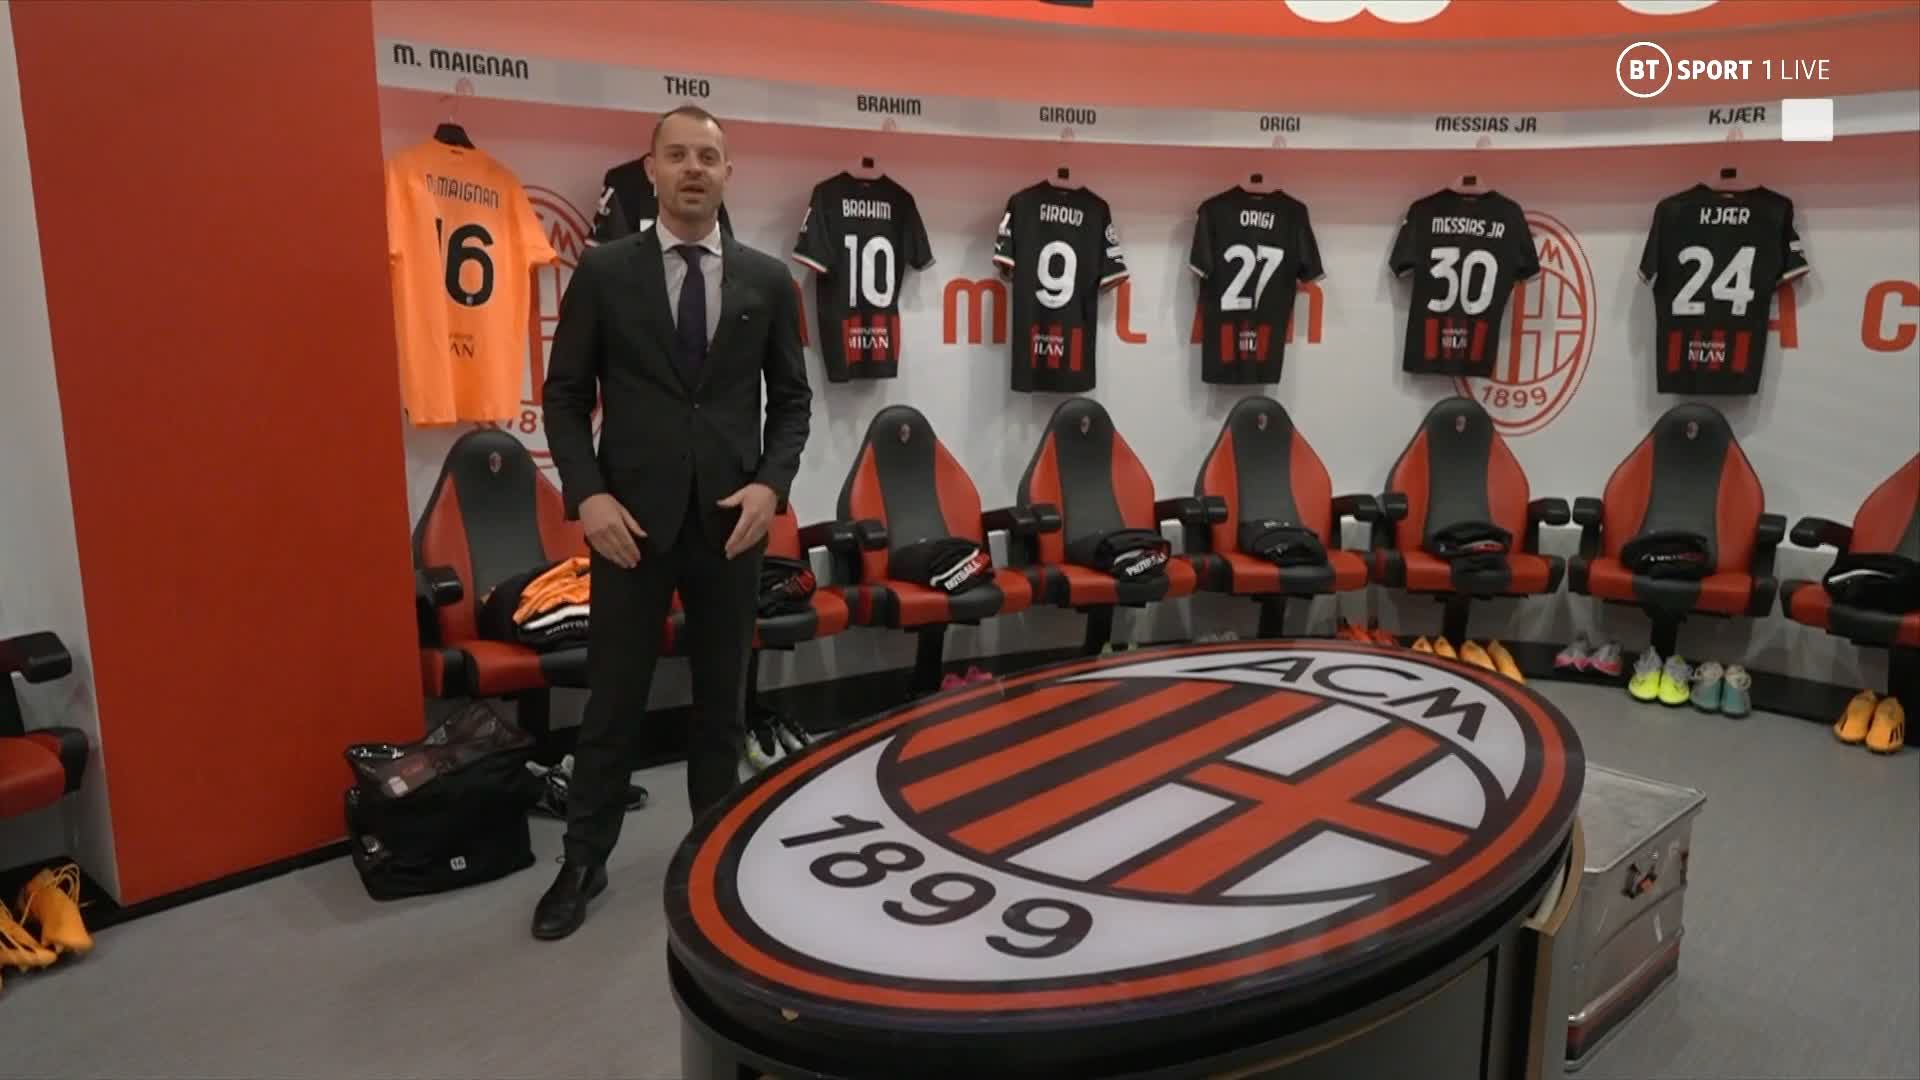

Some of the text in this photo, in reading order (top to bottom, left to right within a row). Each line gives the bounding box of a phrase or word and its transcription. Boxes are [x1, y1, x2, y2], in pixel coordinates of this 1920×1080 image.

[392, 43, 529, 79] M. MAIGNAN
[664, 75, 711, 98] THEO
[856, 94, 921, 116] BRAHIM
[1039, 106, 1097, 125] GIROUD
[1259, 115, 1301, 133] ORIGI
[1435, 115, 1537, 133] MESSIAS JR
[437, 175, 500, 209] MAIGNAN
[842, 198, 891, 220] BRAHIM
[1039, 203, 1084, 226] GIROUD
[1239, 209, 1275, 231] ORIGI
[1431, 215, 1506, 240] MESSIAS JR
[844, 234, 895, 308] 10
[1035, 240, 1077, 309] 9
[1220, 244, 1285, 311] 27
[1427, 246, 1499, 315] 30
[1672, 245, 1757, 316] 24
[1033, 341, 1065, 357] ILAN
[1482, 386, 1548, 409] 1899
[1181, 656, 1487, 742] ACM
[780, 814, 1094, 959] 1899
